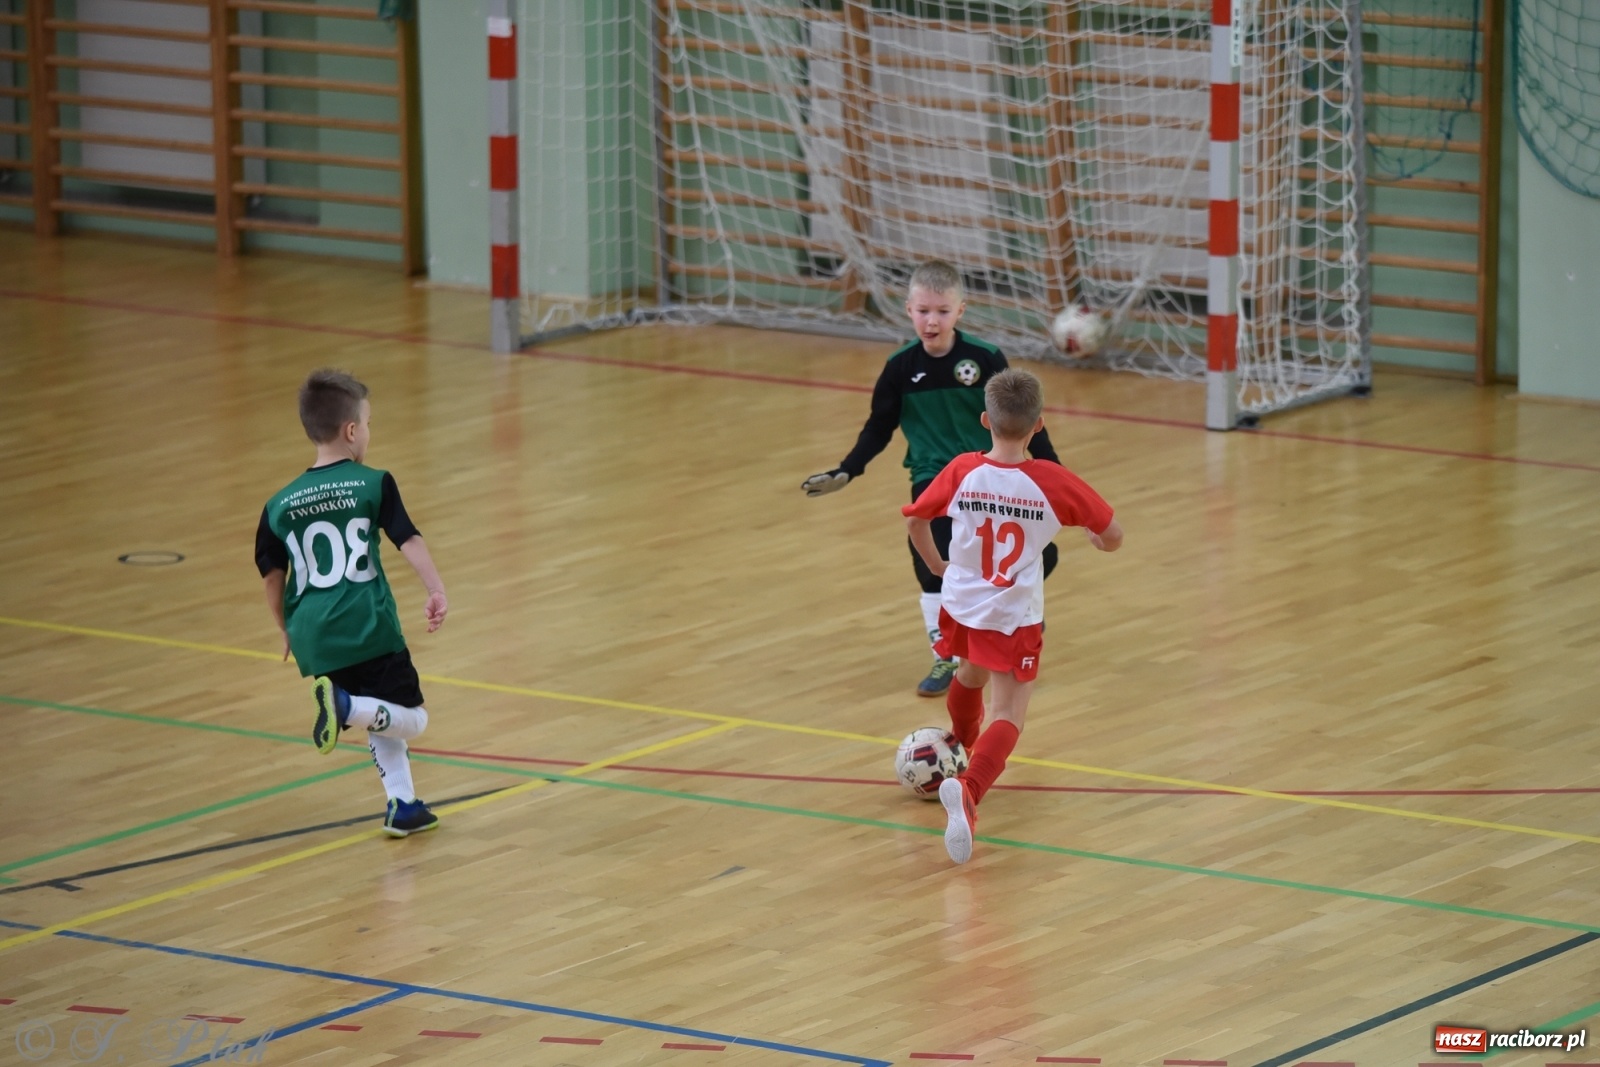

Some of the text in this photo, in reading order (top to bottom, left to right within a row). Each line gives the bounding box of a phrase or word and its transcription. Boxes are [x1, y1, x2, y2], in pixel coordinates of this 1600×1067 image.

[280, 485, 319, 505] AKADEMIA
[960, 491, 996, 501] KADEMIA
[286, 496, 358, 520] TWORKÓW
[957, 500, 1044, 521] RYMER RYBNIK
[285, 517, 378, 597] 108
[975, 517, 1025, 589] 12
